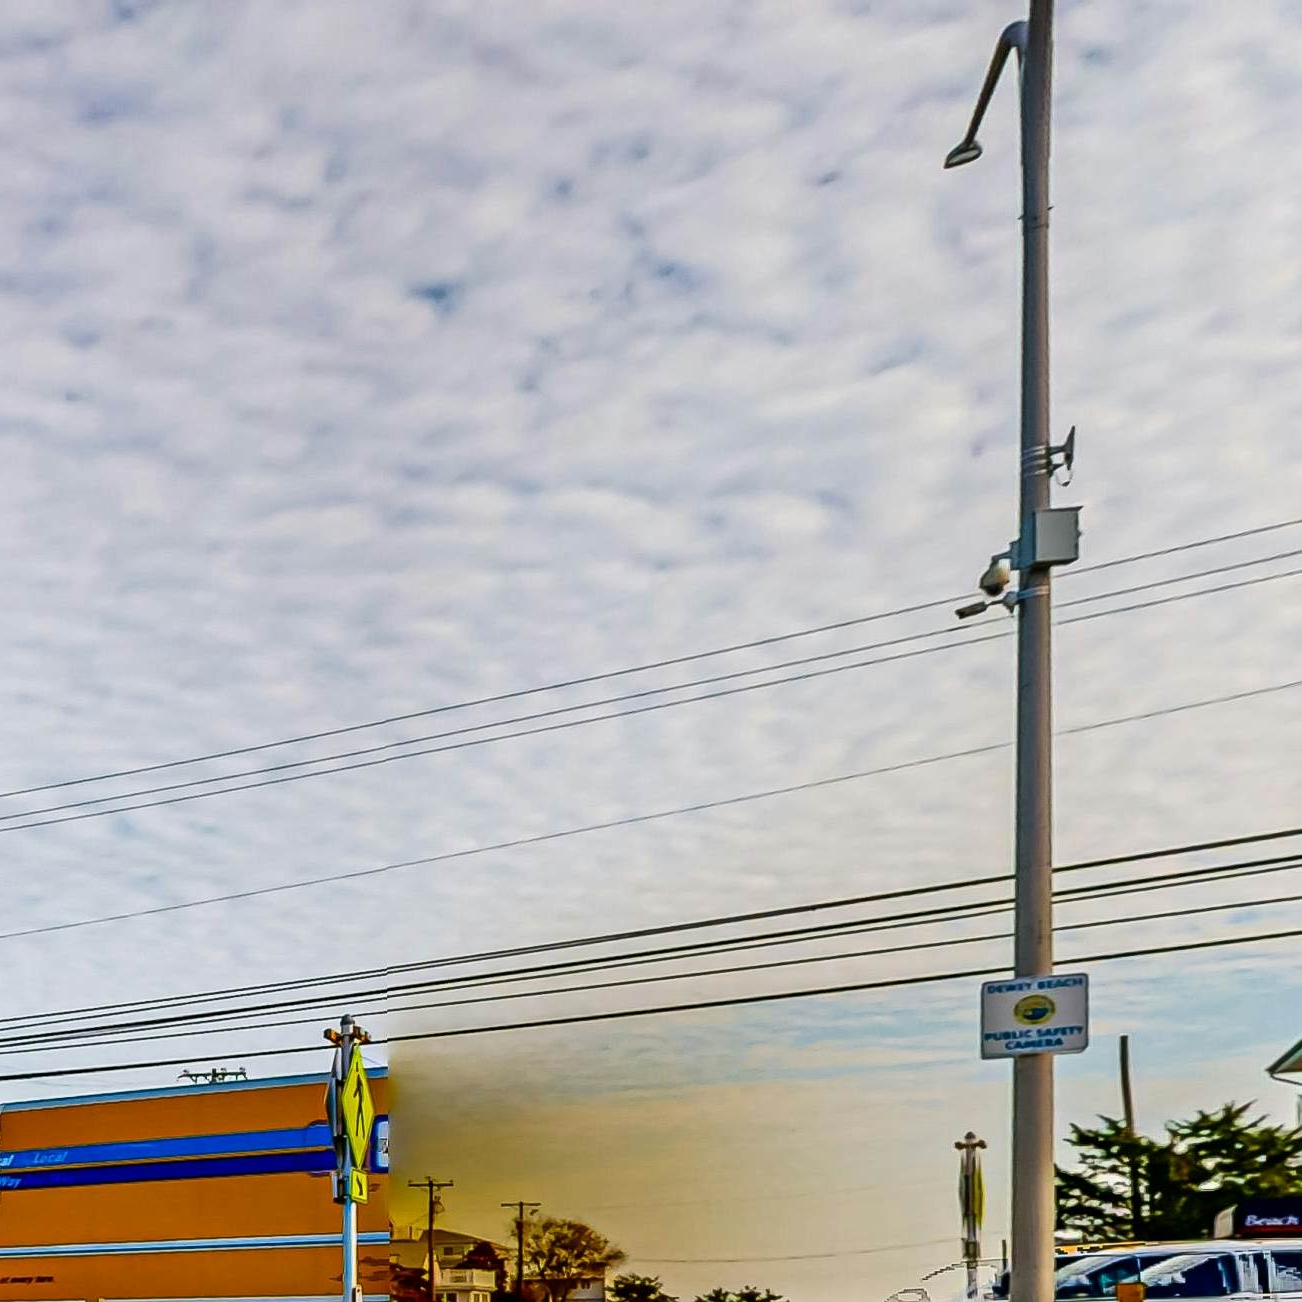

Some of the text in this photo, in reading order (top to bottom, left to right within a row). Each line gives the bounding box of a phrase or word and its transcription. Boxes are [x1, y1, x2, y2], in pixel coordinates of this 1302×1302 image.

[987, 978, 1083, 994] DEWEY BEACH
[984, 1025, 1083, 1041] PUBLIC SAFETY
[1005, 1038, 1063, 1050] CAMERA
